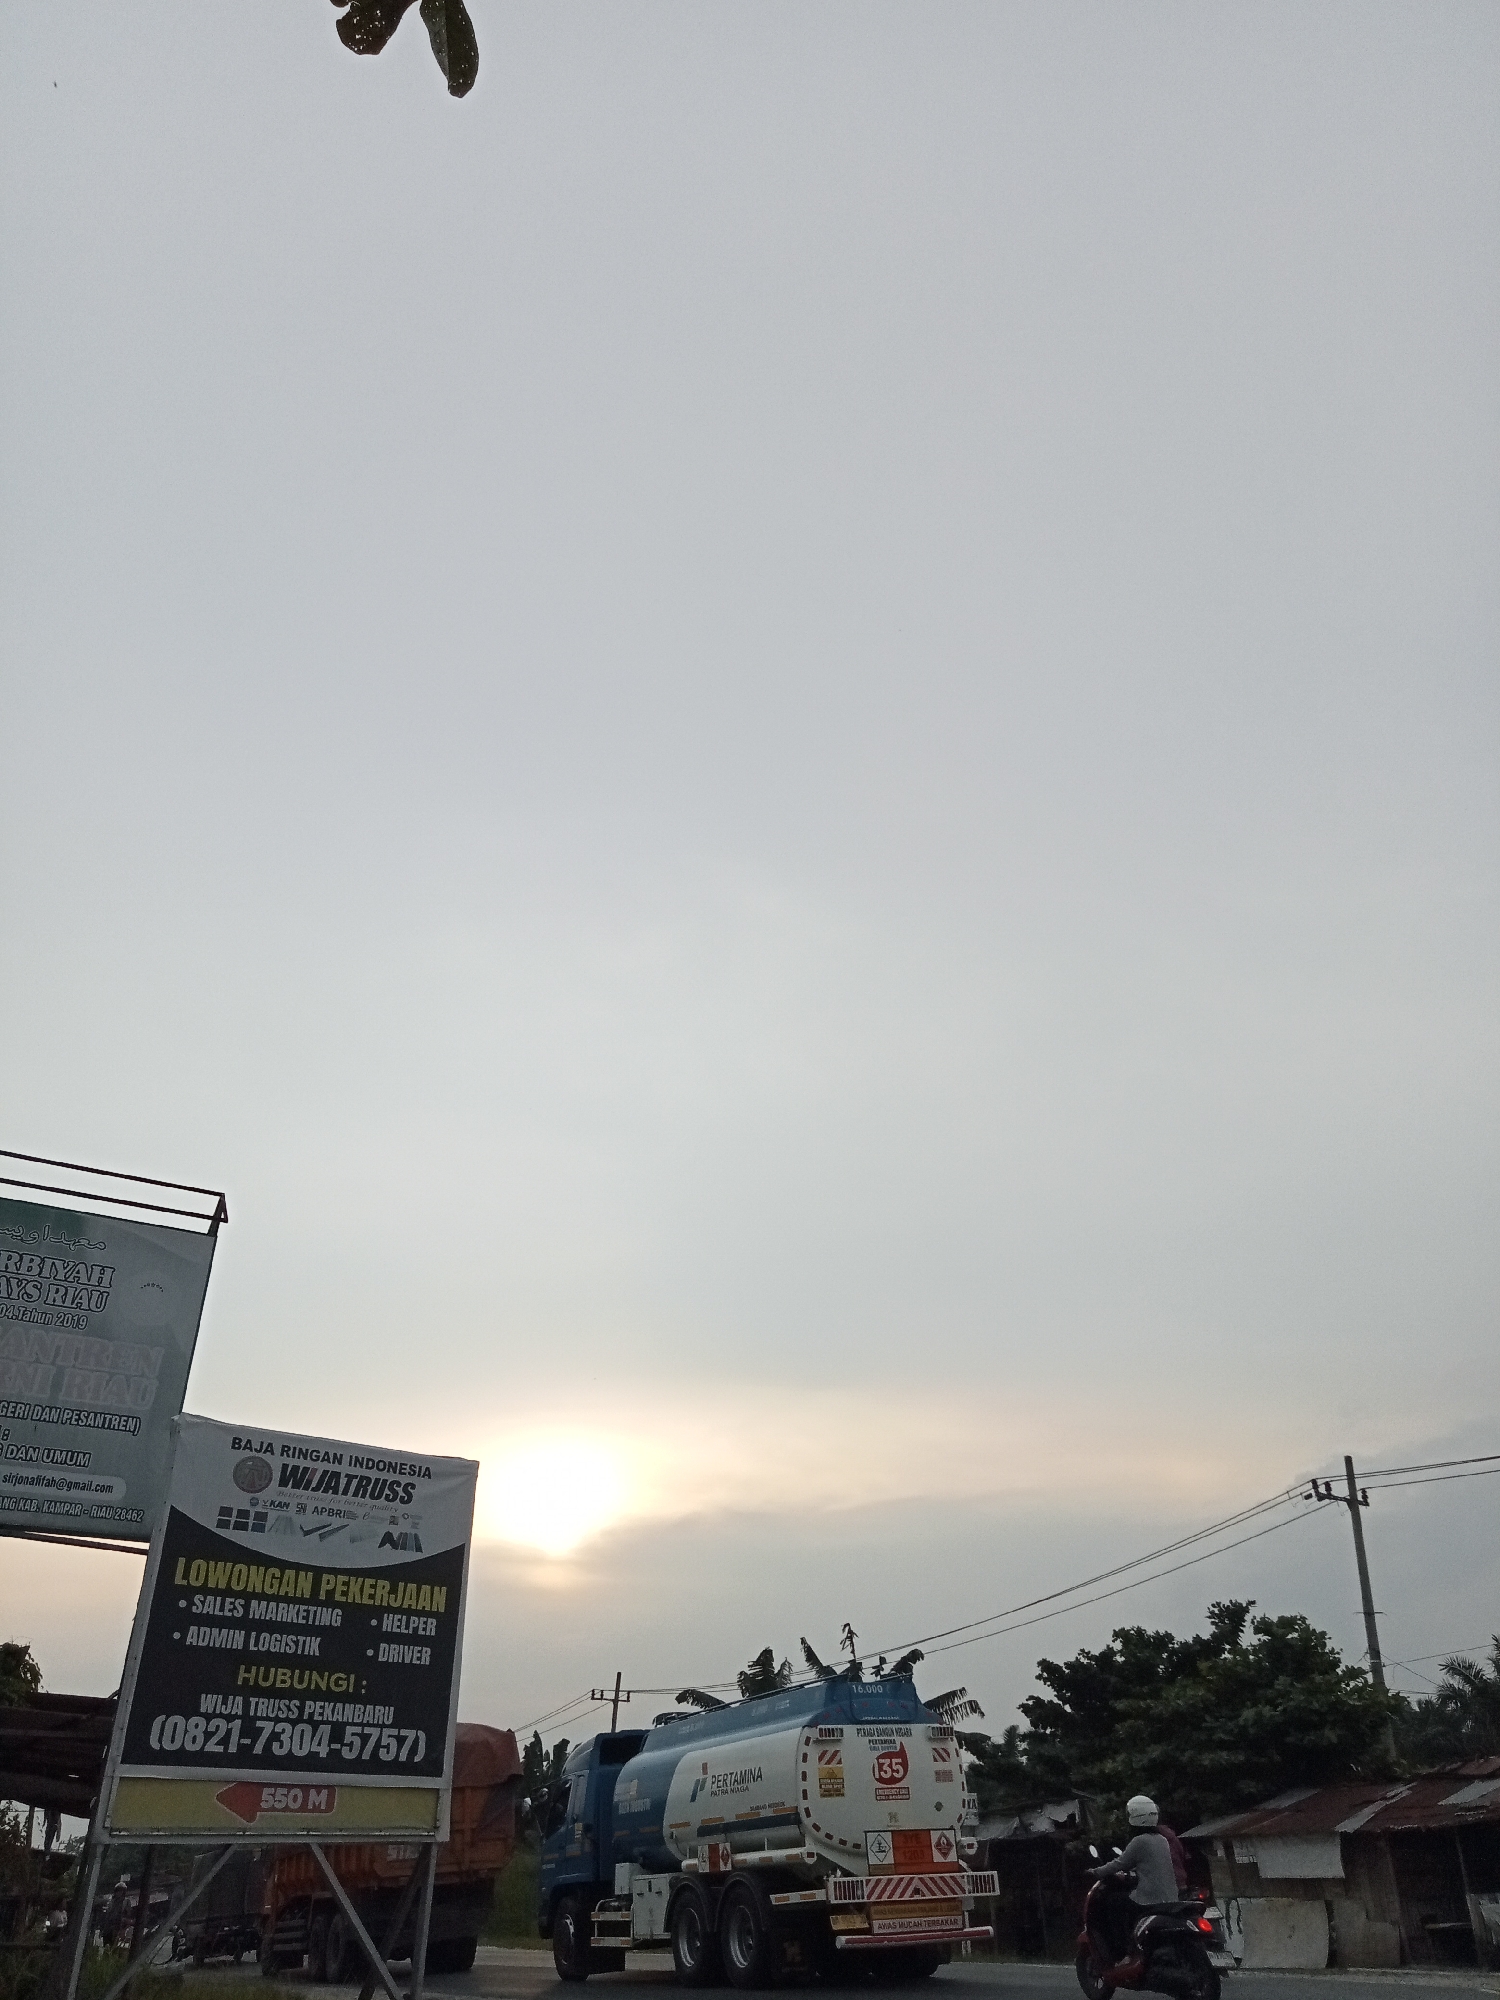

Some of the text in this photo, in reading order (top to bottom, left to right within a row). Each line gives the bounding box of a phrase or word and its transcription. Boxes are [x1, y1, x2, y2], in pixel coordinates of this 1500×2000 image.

[44, 1283, 110, 1313] RIAU
[54, 1312, 88, 1330] 2019
[59, 1367, 160, 1411] RIAU
[31, 1404, 62, 1424] DAN
[61, 1408, 141, 1436] PESANTREN)
[5, 1444, 39, 1463] DAN
[41, 1448, 91, 1468] UMUM
[231, 1436, 432, 1479] BAJA RINGAN INDONESIA
[2, 1472, 114, 1494] sirjonafifah@gmail.com
[278, 1463, 417, 1505] WIJATRUSS
[17, 1497, 39, 1512] KAB.
[42, 1500, 82, 1517] KAMPAR
[90, 1505, 113, 1519] RIAU
[113, 1507, 144, 1523] 28462
[268, 1500, 291, 1510] KAN
[174, 1557, 447, 1613] LOWONGAN PEKERJAAN
[192, 1594, 342, 1627] SALES MARKETING
[382, 1613, 437, 1636] HELPER
[186, 1626, 322, 1656] ADMIN LOGISTIK
[378, 1643, 431, 1665] DRIVER
[237, 1664, 355, 1693] HUBUNGI
[200, 1693, 395, 1725] WIJA TRUSS PEKANBARU
[149, 1714, 427, 1763] (0821-7304-5757)
[710, 1766, 763, 1790] PERTAMINA
[873, 1759, 904, 1779] 135
[260, 1787, 329, 1810] 550 M
[710, 1785, 750, 1797] PATRA NIAGA
